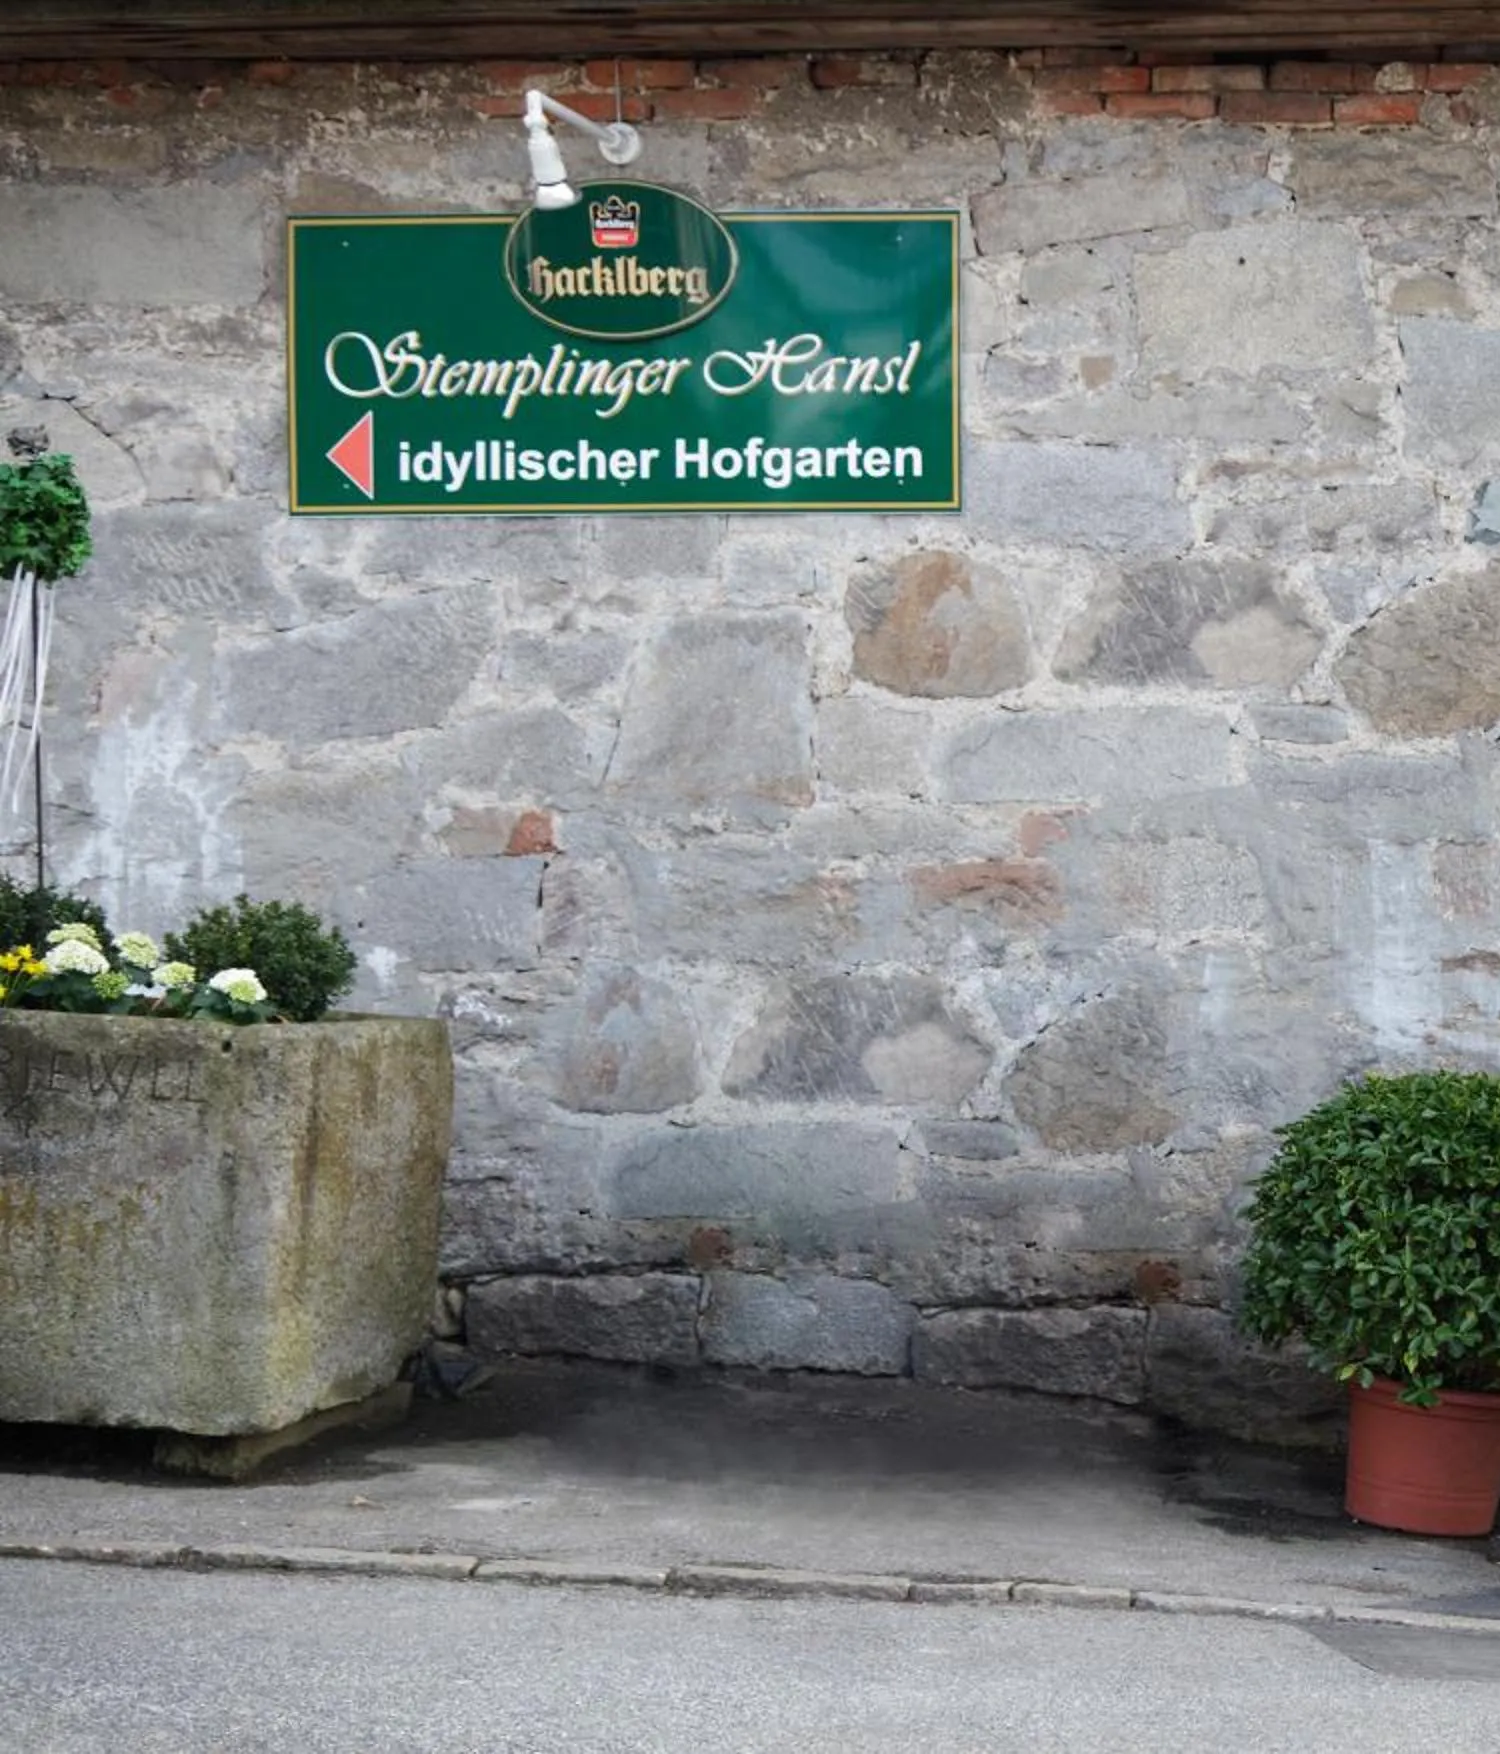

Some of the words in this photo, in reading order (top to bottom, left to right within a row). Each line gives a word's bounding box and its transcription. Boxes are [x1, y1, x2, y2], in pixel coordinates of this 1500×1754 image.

[324, 331, 690, 420] Stemplinger
[703, 333, 922, 396] Hansl
[399, 439, 660, 491] idyllischer
[675, 437, 923, 488] Hofgarten
